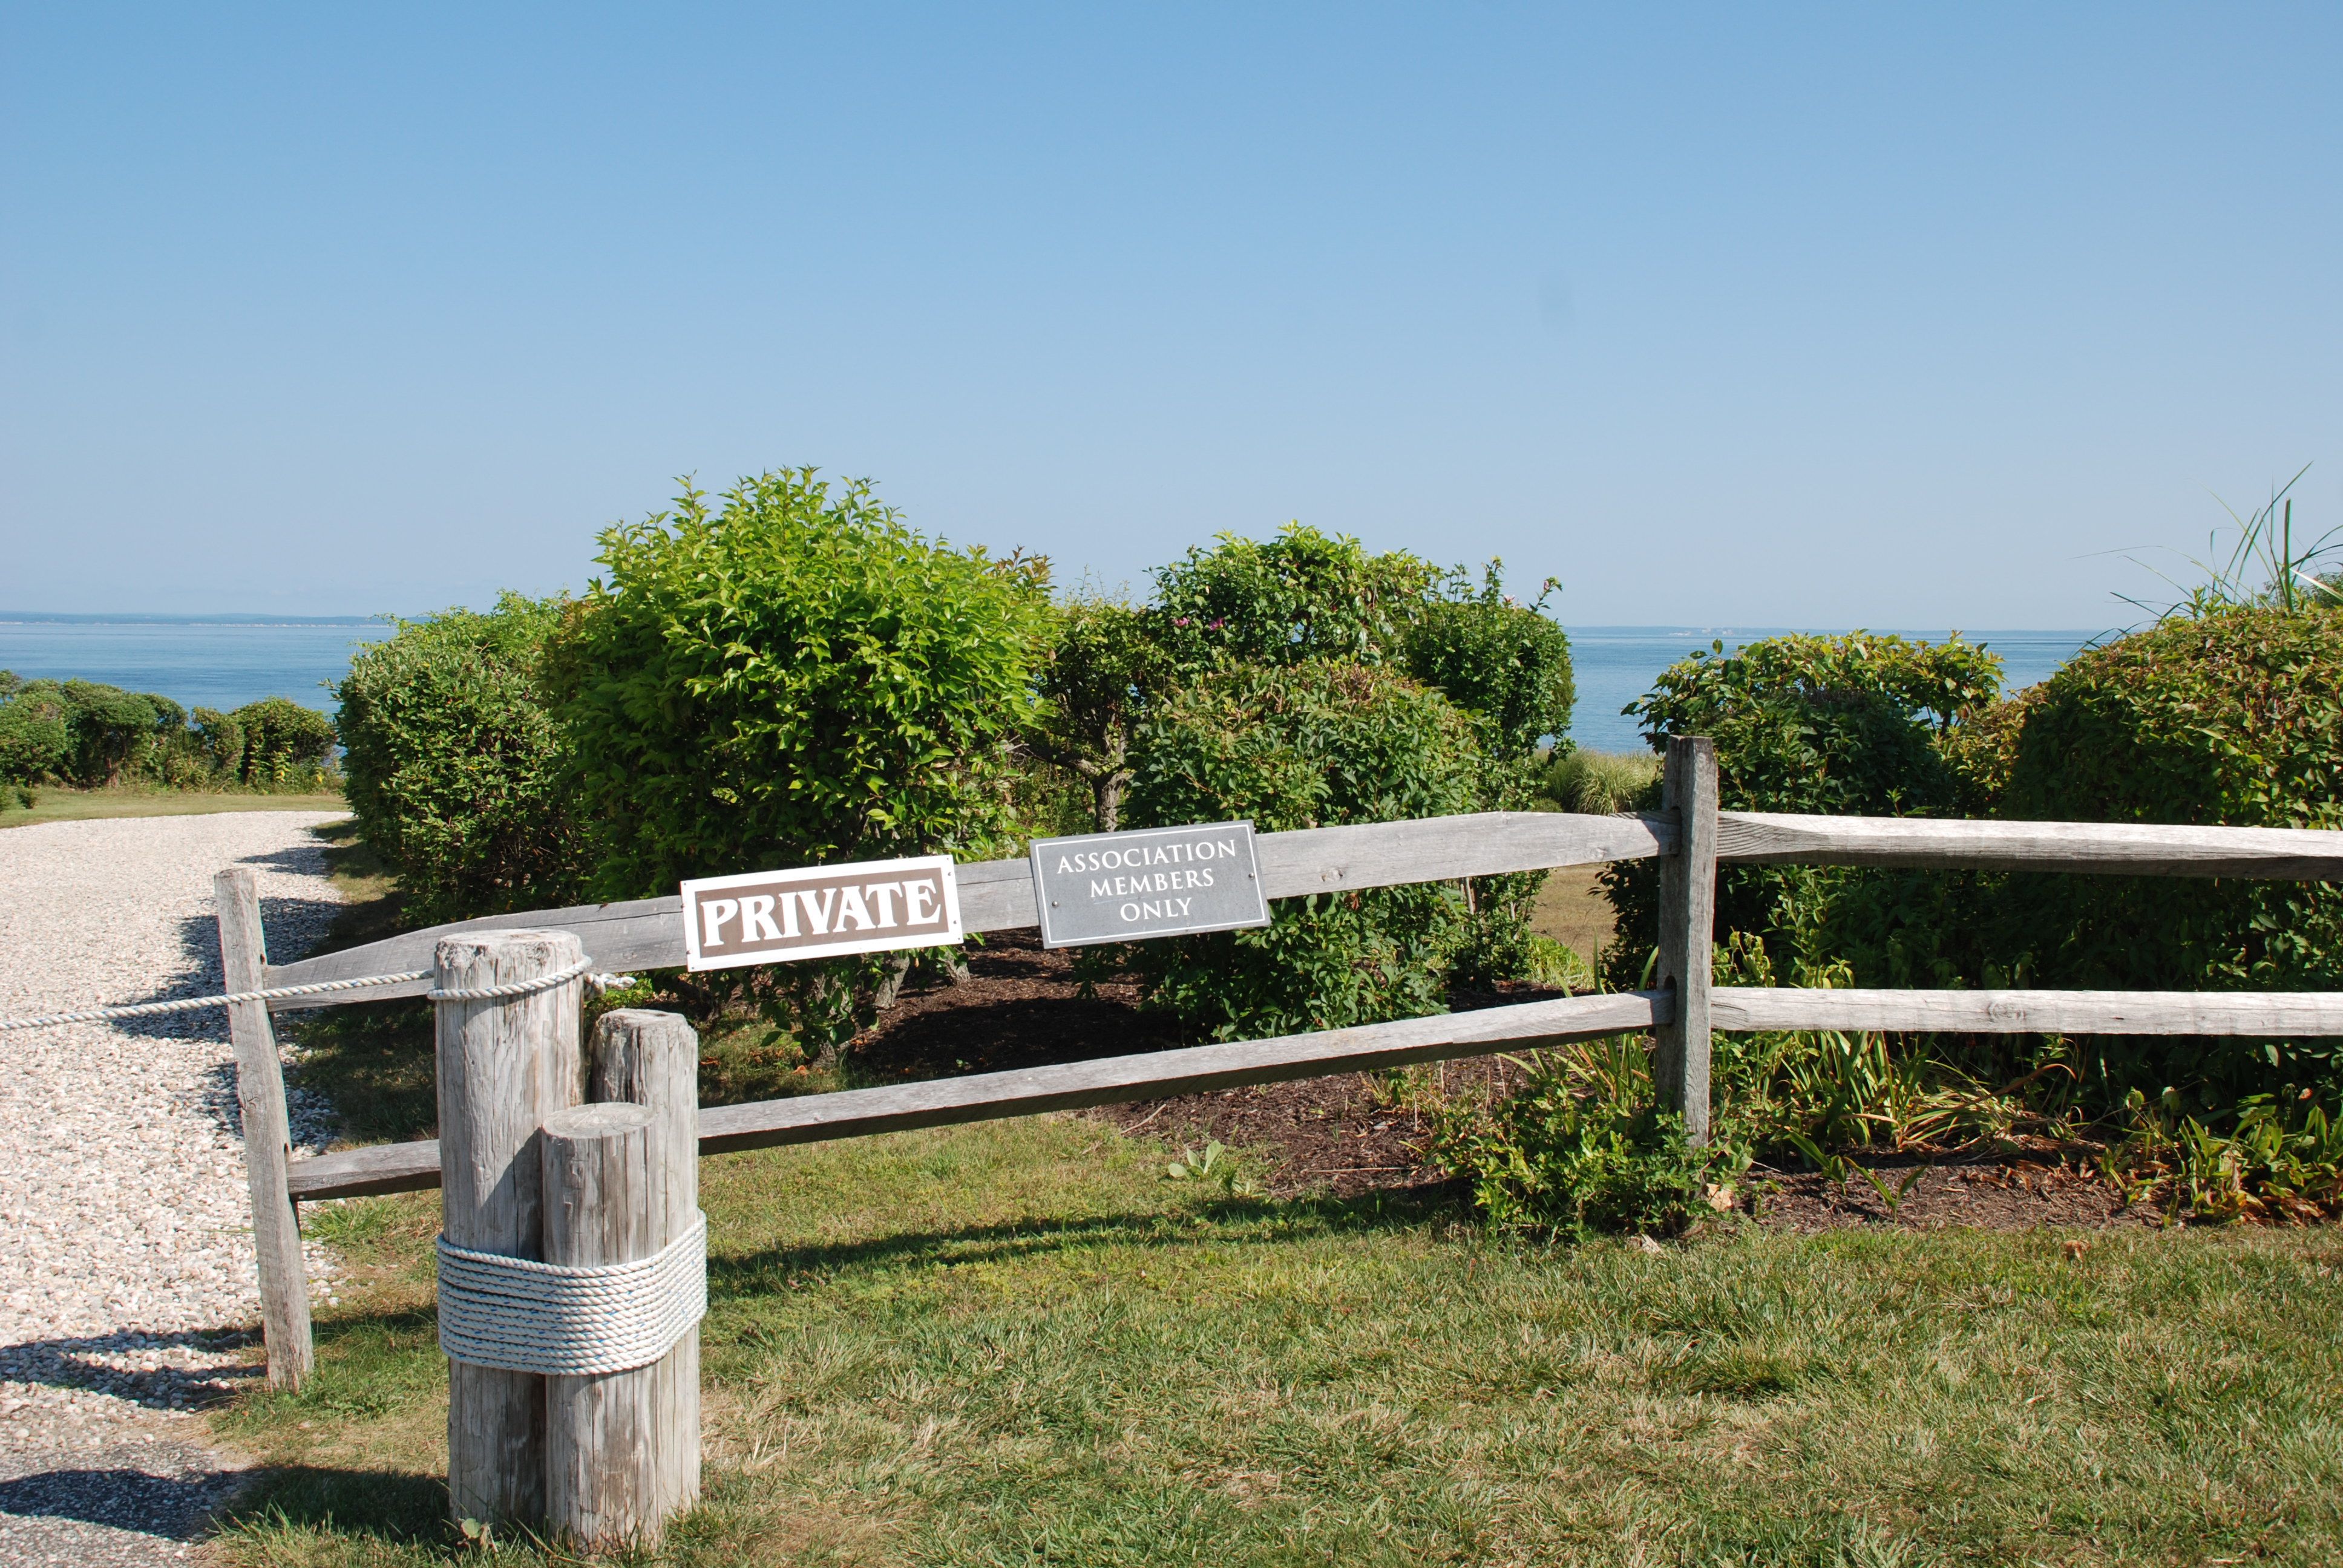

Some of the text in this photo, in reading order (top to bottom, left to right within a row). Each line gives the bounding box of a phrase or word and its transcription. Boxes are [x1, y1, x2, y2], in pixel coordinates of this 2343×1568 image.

[1057, 840, 1237, 874] ASSOCIATION
[1090, 868, 1214, 898] MEMBERS
[701, 878, 941, 947] PRIVATE
[1120, 897, 1192, 921] ONLY
